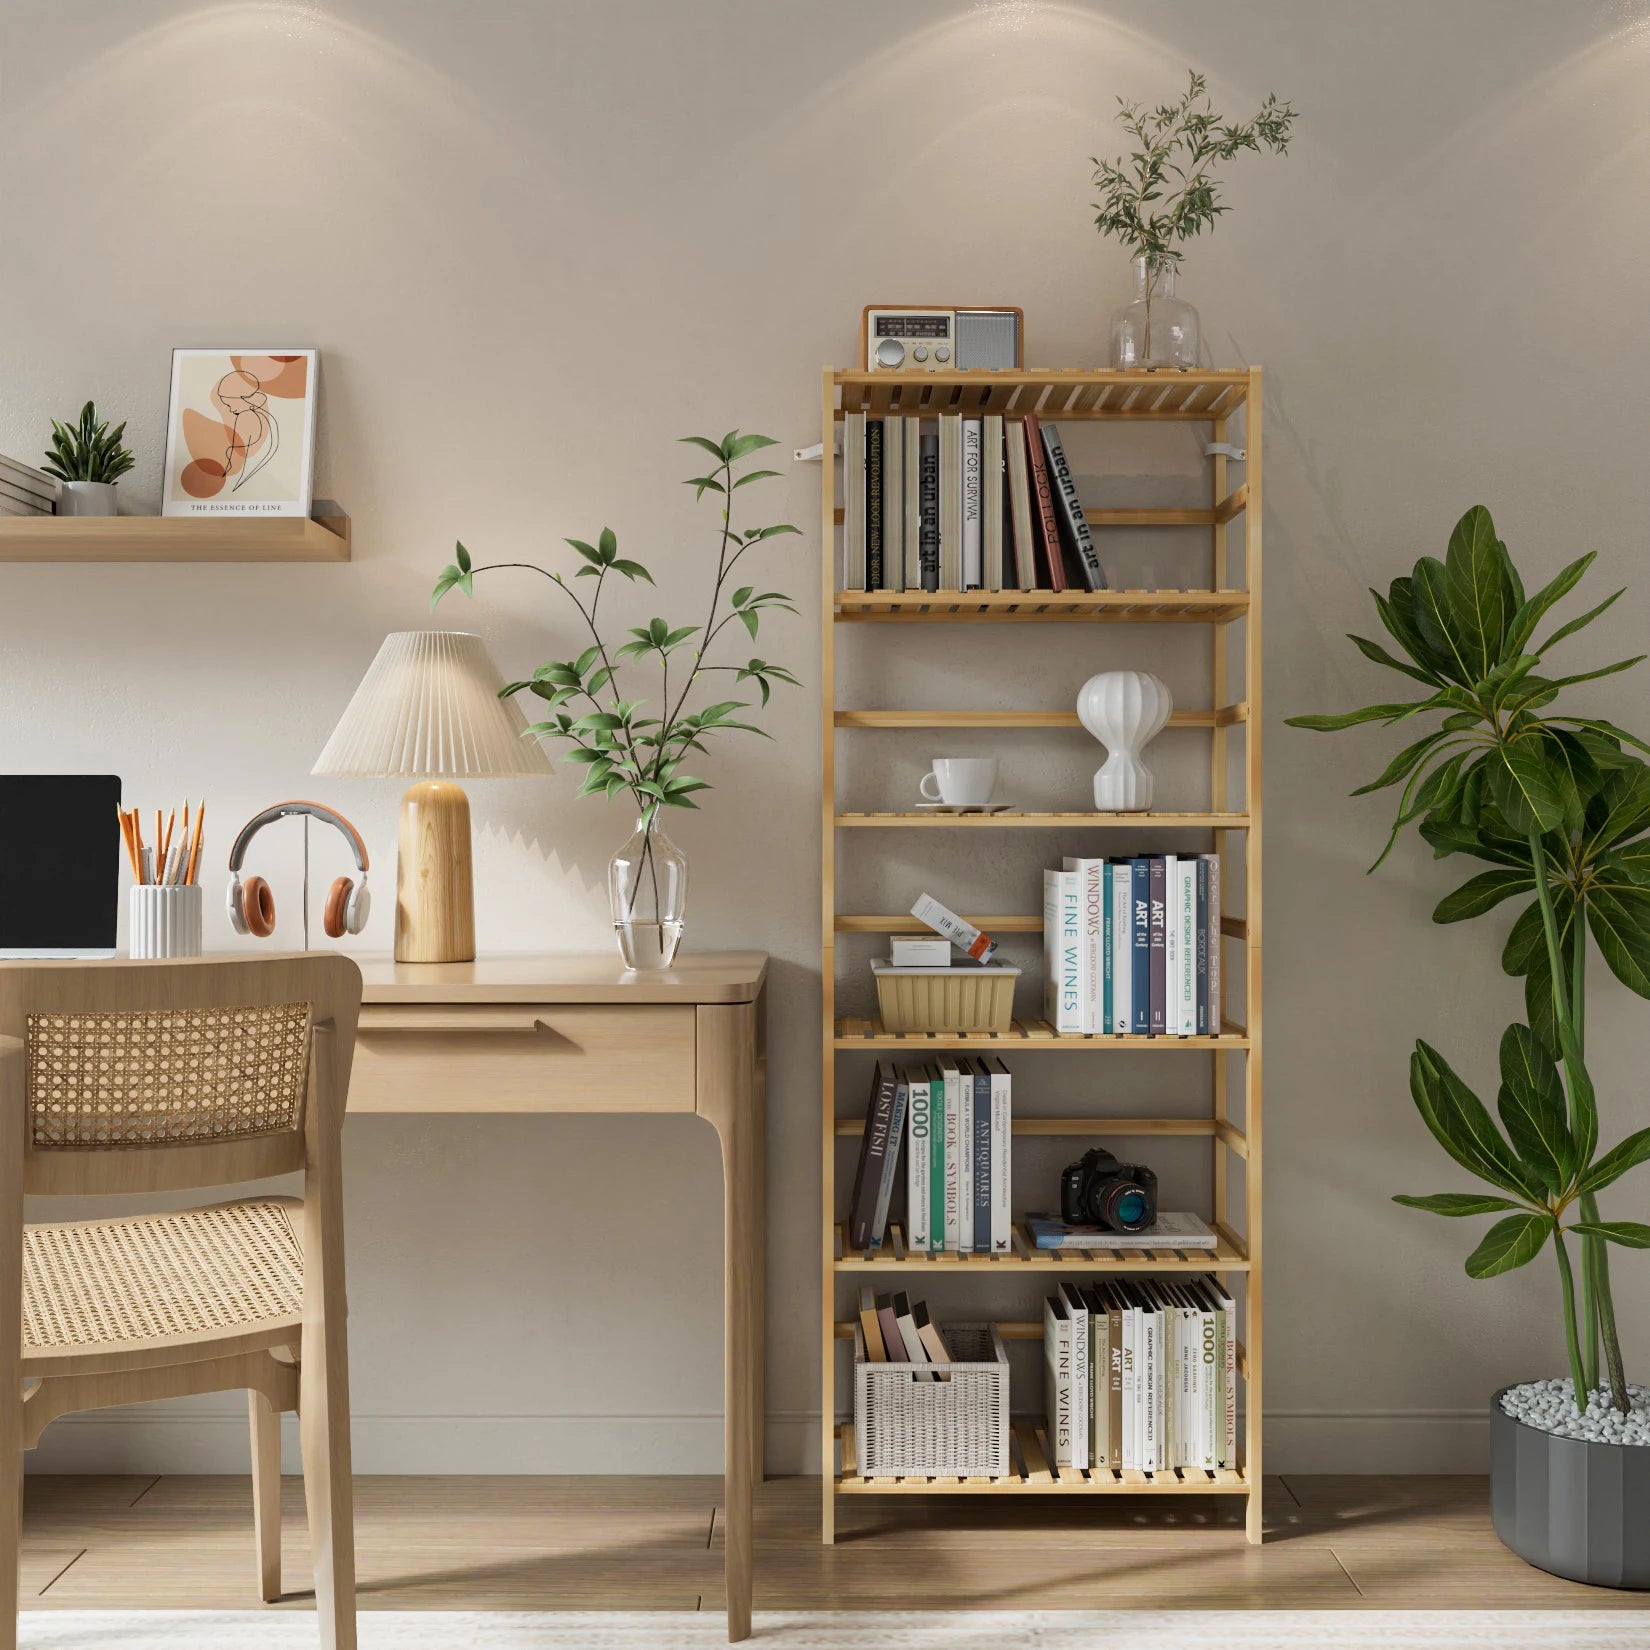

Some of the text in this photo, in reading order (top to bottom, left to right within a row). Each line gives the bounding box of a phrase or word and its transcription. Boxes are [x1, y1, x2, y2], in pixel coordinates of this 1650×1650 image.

[872, 428, 880, 496] REVOLUTION
[967, 430, 978, 521] ART FOR SURVIVAL
[872, 498, 880, 527] LOOK
[921, 455, 936, 573] art in an urban
[1051, 445, 1099, 568] art in an urban
[872, 529, 880, 553] NEW
[1064, 894, 1078, 937] FINE
[1087, 865, 1100, 936] WINDOWS
[1136, 900, 1148, 928] ART
[1152, 900, 1164, 928] ART
[1064, 947, 1078, 1011] WINES
[871, 1082, 894, 1156] LOST FISH
[890, 1092, 905, 1146] MAKING IT
[912, 1089, 928, 1138] 1000
[947, 1113, 957, 1148] BOOK
[979, 1120, 990, 1207] ANTIQUAIRES
[947, 1162, 957, 1226] SYMBOLS
[1059, 1340, 1069, 1380] FINE
[1075, 1316, 1086, 1379] WINDOWS
[1112, 1348, 1121, 1372] ART
[1124, 1348, 1132, 1372] ART
[1203, 1318, 1214, 1364] 1000
[1059, 1388, 1069, 1447] WINES
